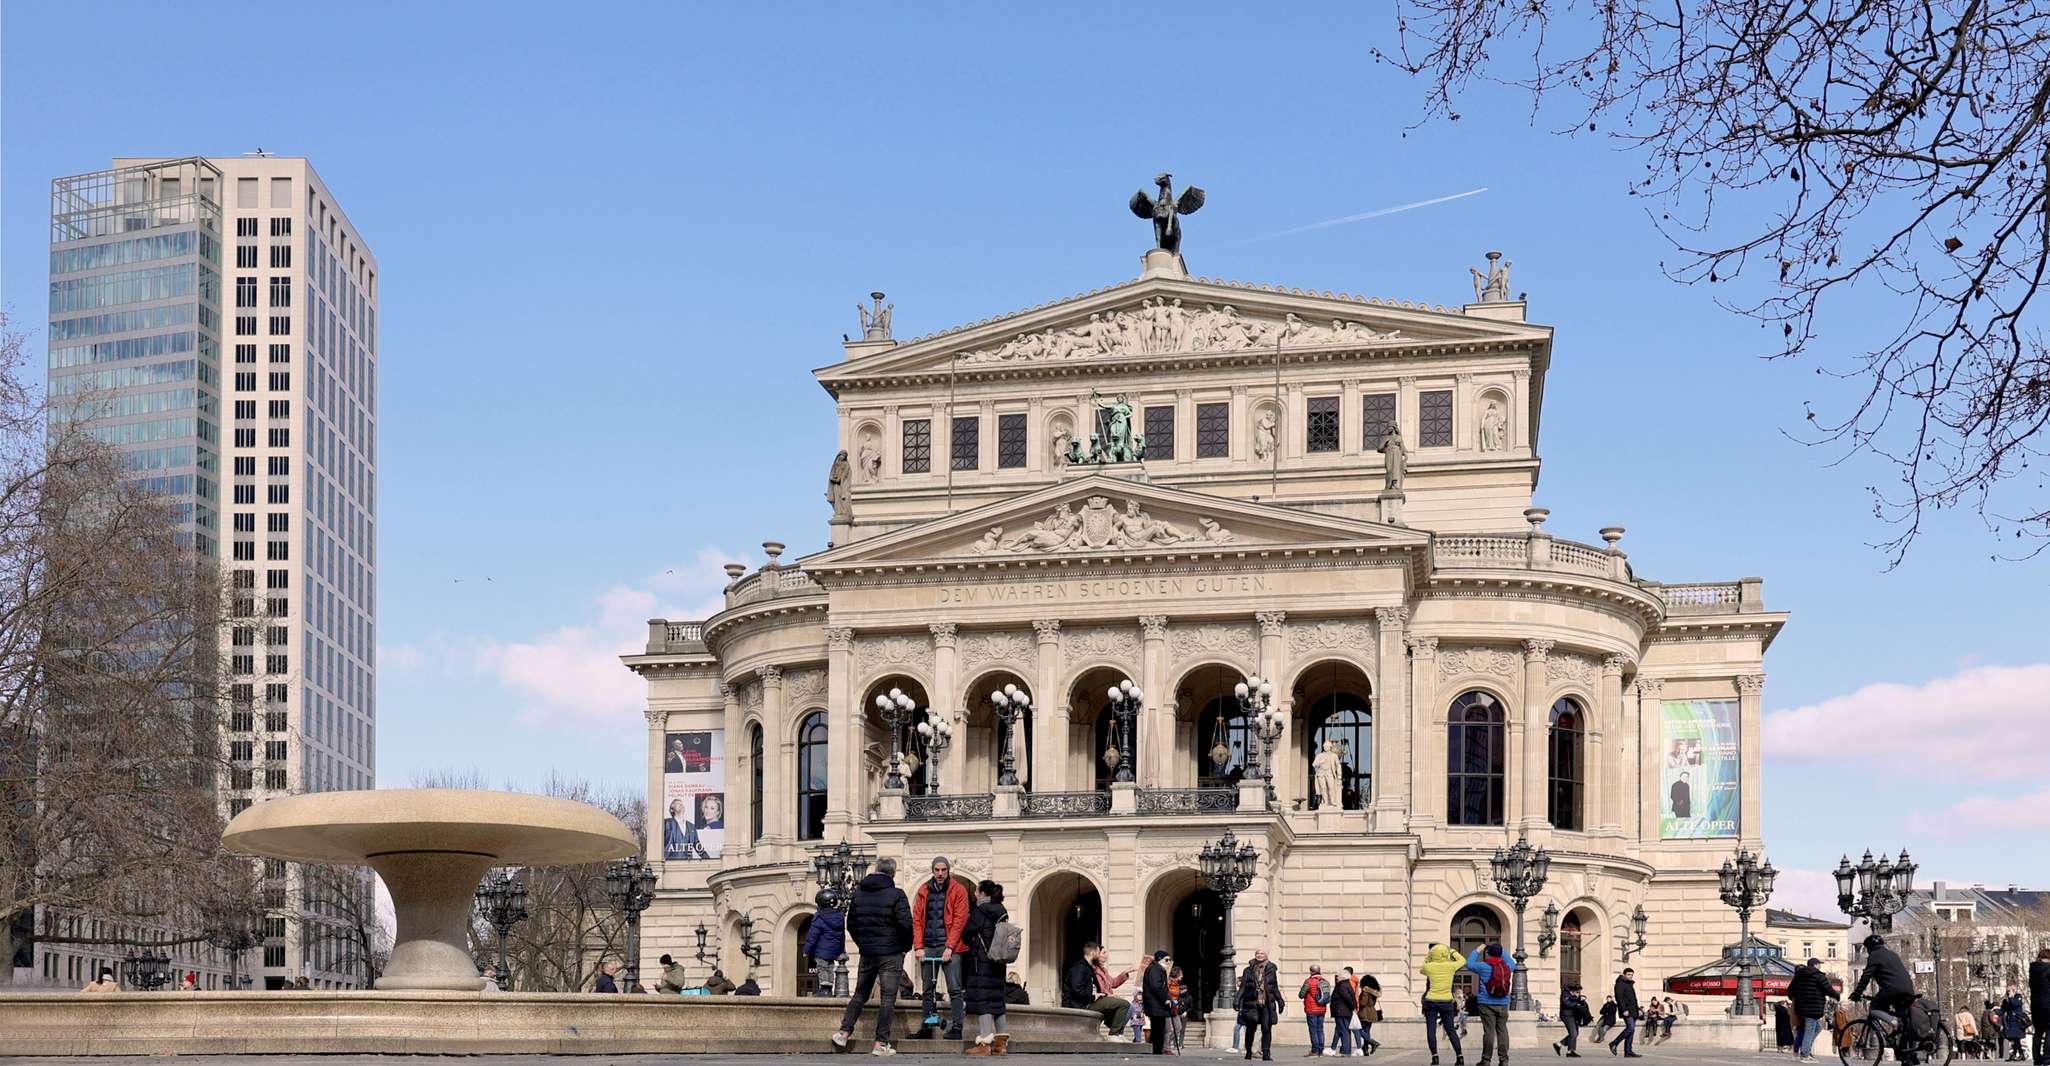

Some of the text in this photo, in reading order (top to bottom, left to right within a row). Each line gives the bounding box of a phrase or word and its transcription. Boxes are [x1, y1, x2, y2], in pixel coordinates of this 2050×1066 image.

[940, 575, 1273, 603] DEM WAHREN SCHOENEN GUTEN.
[1702, 820, 1735, 830] OPER
[669, 842, 693, 852] ALTE
